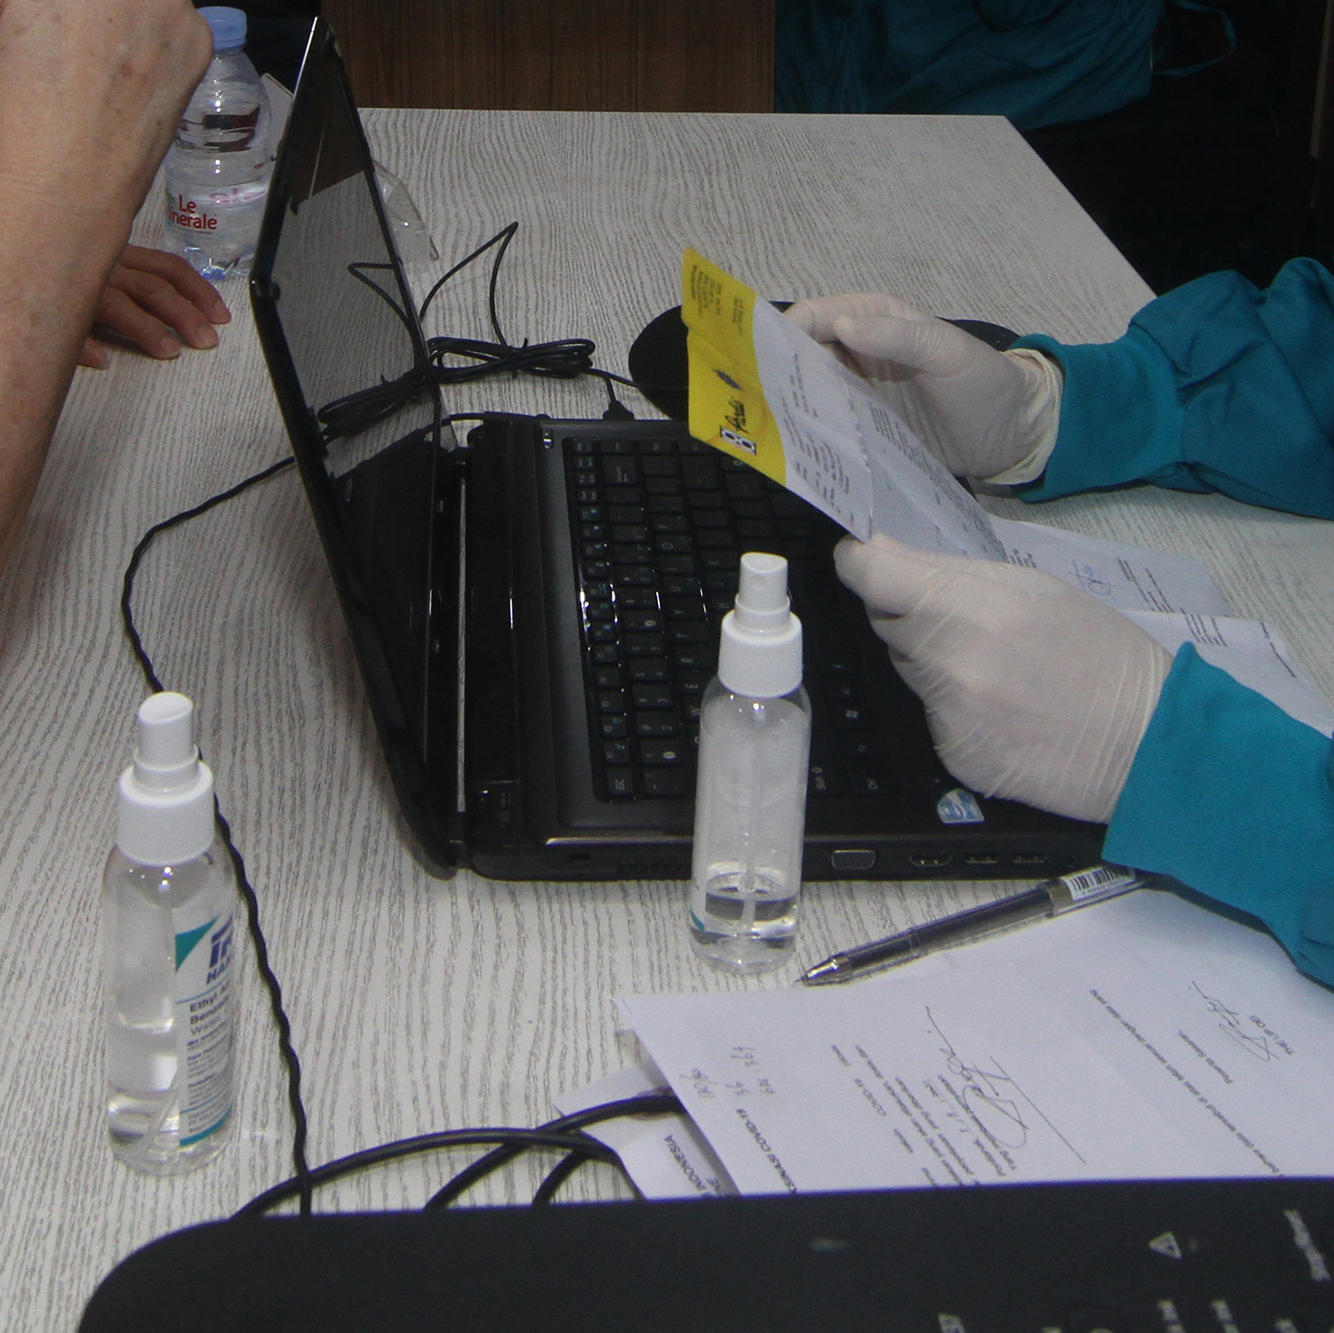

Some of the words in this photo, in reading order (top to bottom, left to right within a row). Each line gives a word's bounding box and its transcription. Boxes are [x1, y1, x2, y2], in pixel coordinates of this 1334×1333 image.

[178, 195, 196, 213] Le
[735, 1106, 771, 1153] COVID-19
[663, 1135, 705, 1192] INDONESIA
